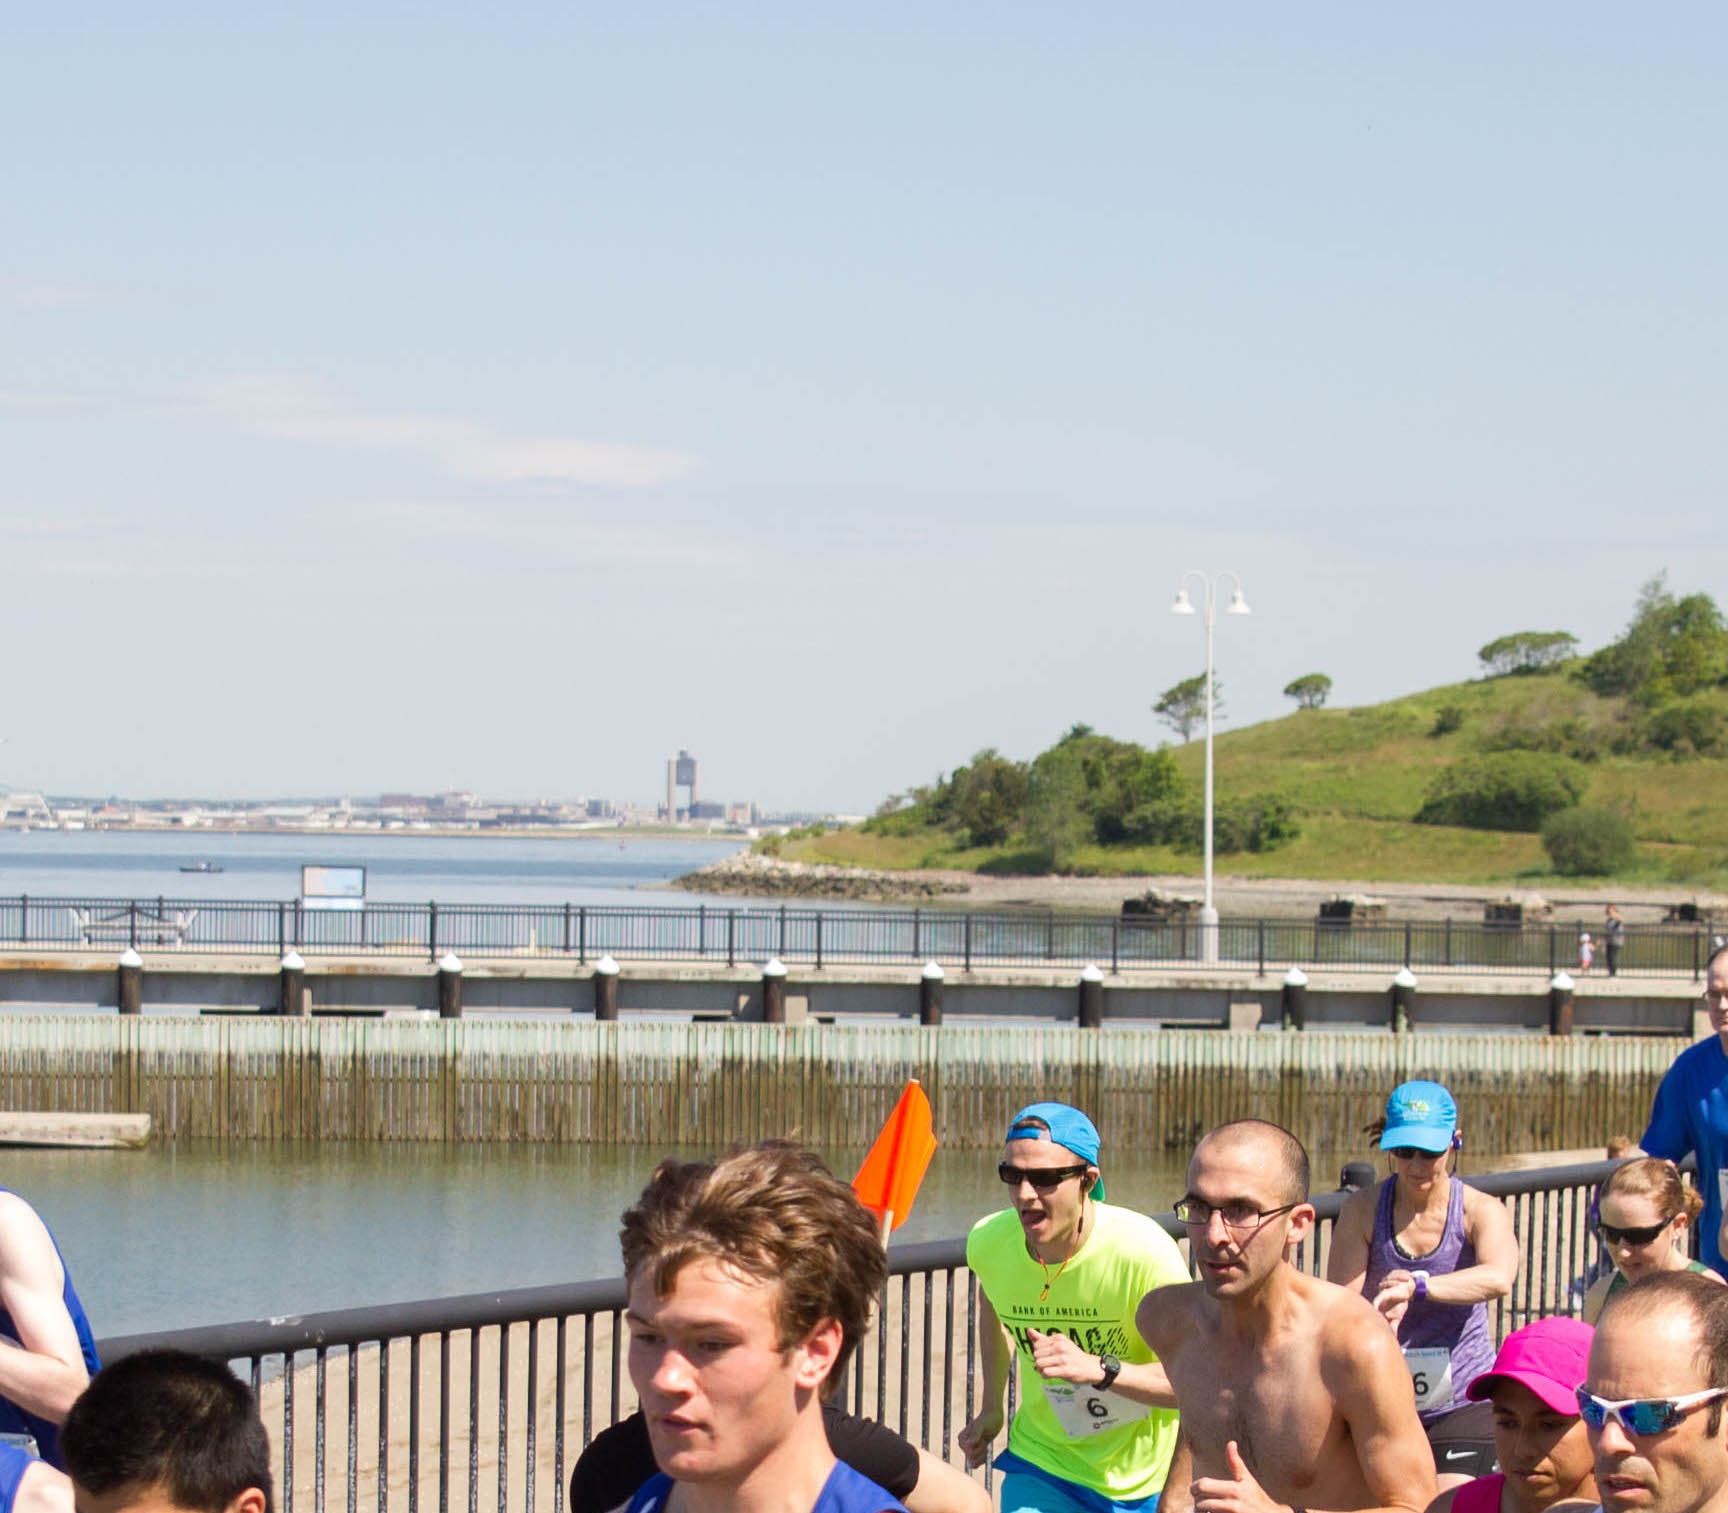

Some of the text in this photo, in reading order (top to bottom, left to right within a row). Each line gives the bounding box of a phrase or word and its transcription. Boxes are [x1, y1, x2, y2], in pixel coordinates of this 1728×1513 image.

[1012, 1305, 1098, 1317] BANK OF AMERICA
[1086, 1397, 1108, 1418] 6
